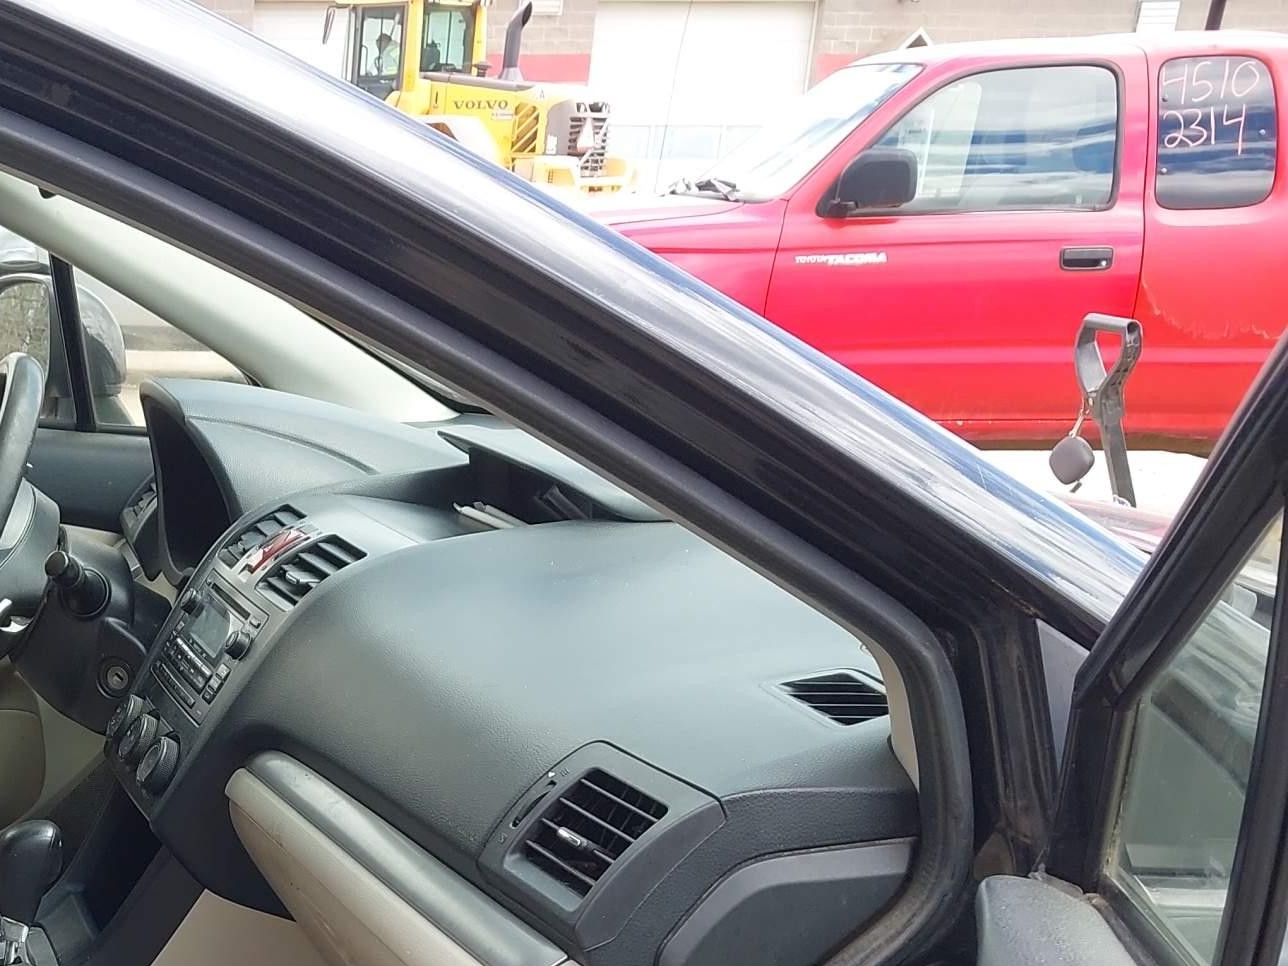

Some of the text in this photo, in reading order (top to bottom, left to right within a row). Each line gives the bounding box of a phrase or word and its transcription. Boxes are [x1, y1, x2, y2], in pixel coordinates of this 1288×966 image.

[1162, 60, 1260, 104] 4510
[453, 100, 509, 110] VOLVO
[1163, 104, 1246, 155] 2314
